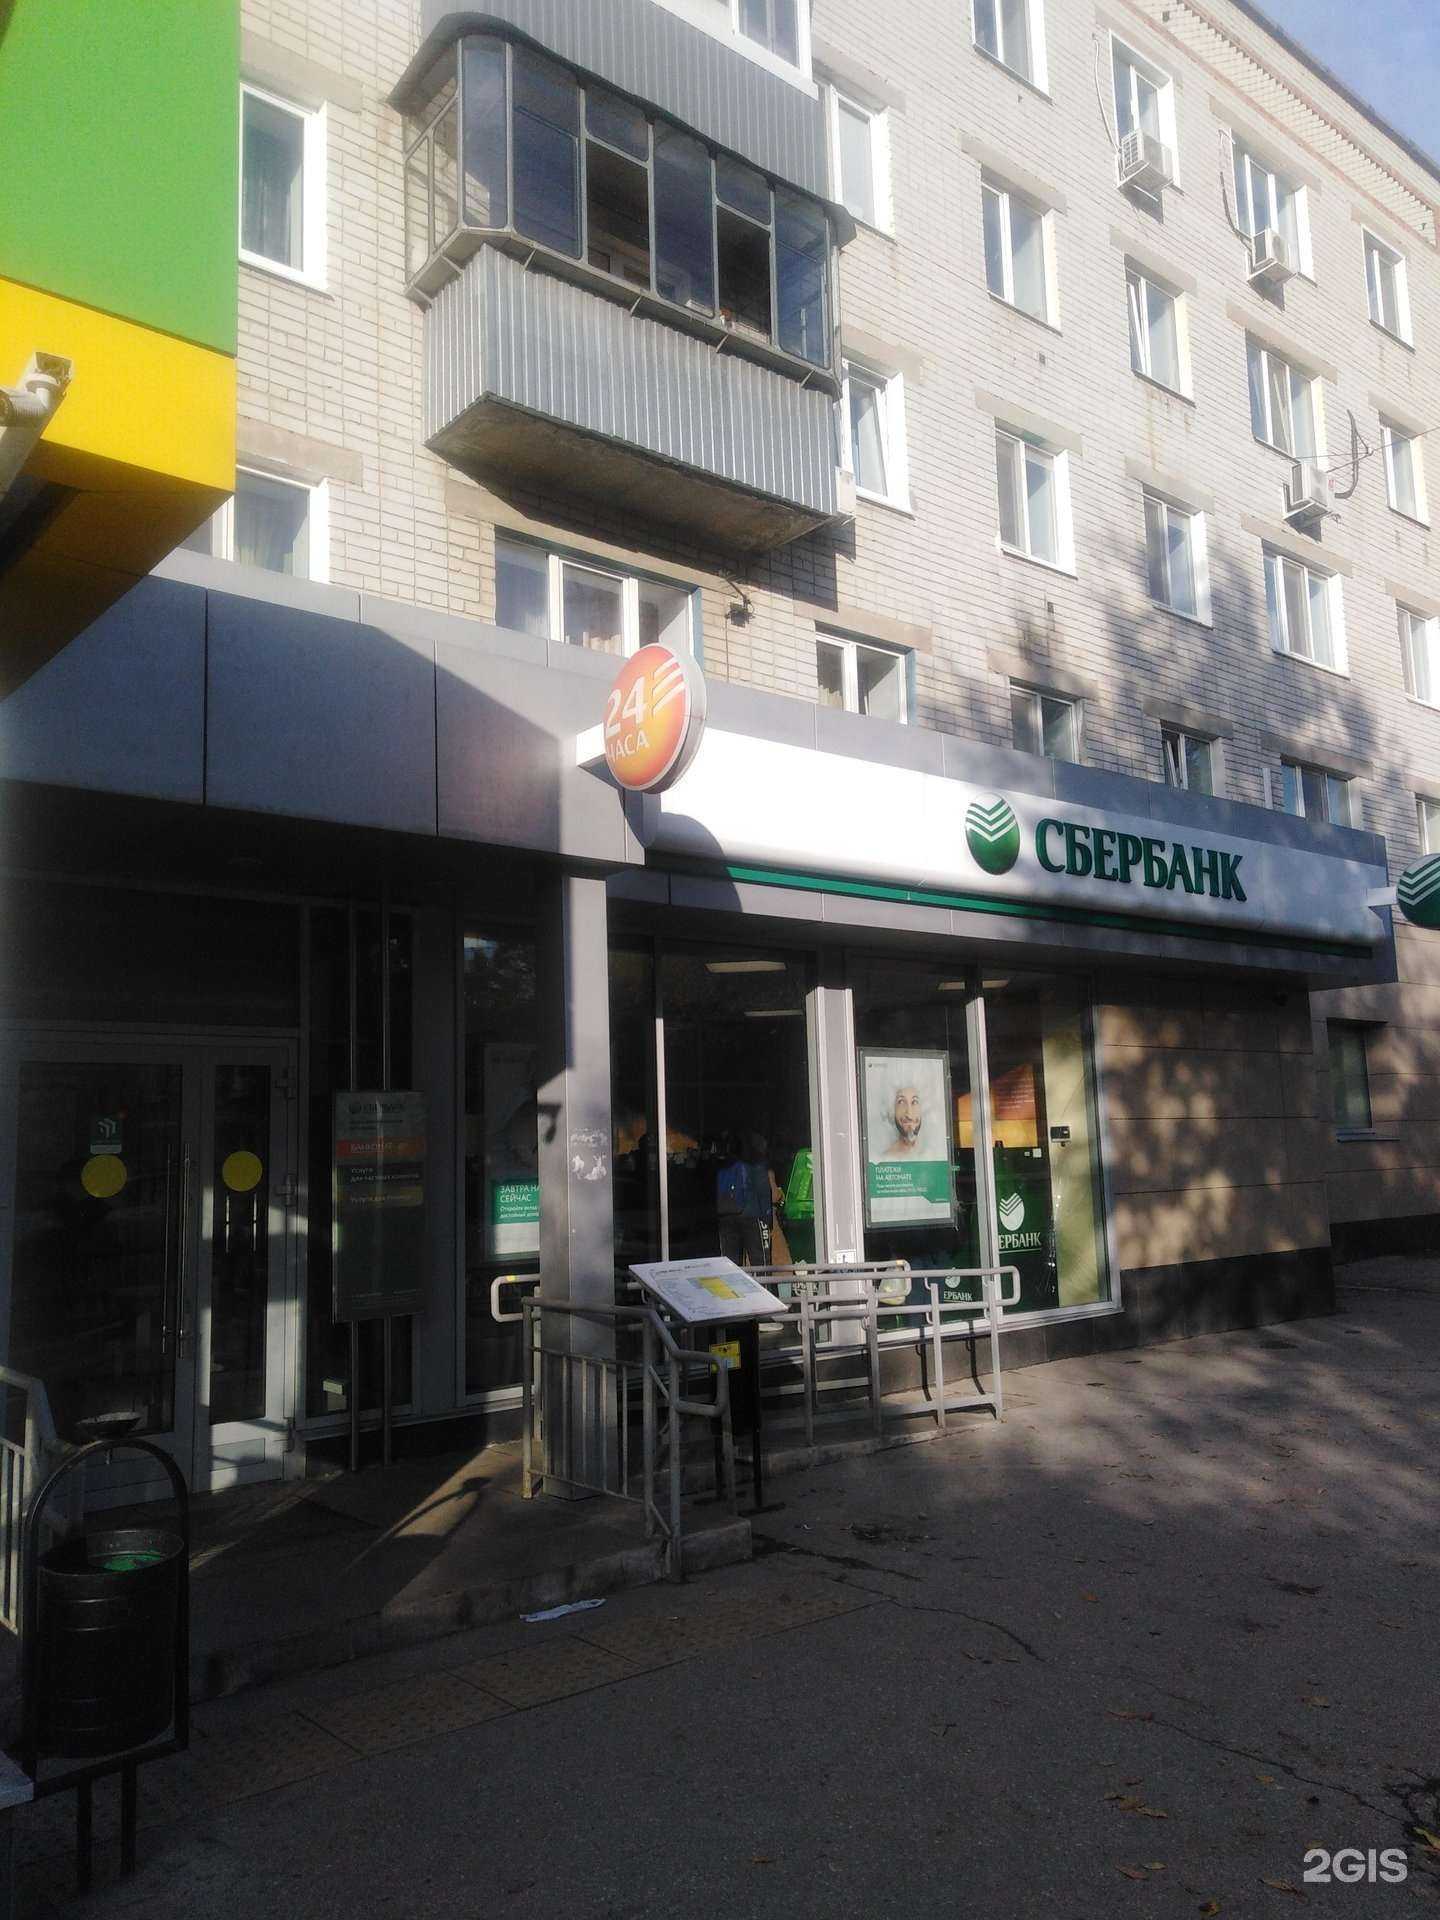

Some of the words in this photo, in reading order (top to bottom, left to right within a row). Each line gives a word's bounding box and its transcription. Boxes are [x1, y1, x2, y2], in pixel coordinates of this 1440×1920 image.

[606, 676, 649, 740] 24
[1035, 817, 1248, 902] СБЕРБАНК
[499, 1184, 530, 1194] ЗАВТРА
[499, 1193, 532, 1204] СЕЙЧАС
[998, 1232, 1042, 1249] ЕРБАНК
[943, 1290, 973, 1302] ЕРБАНК
